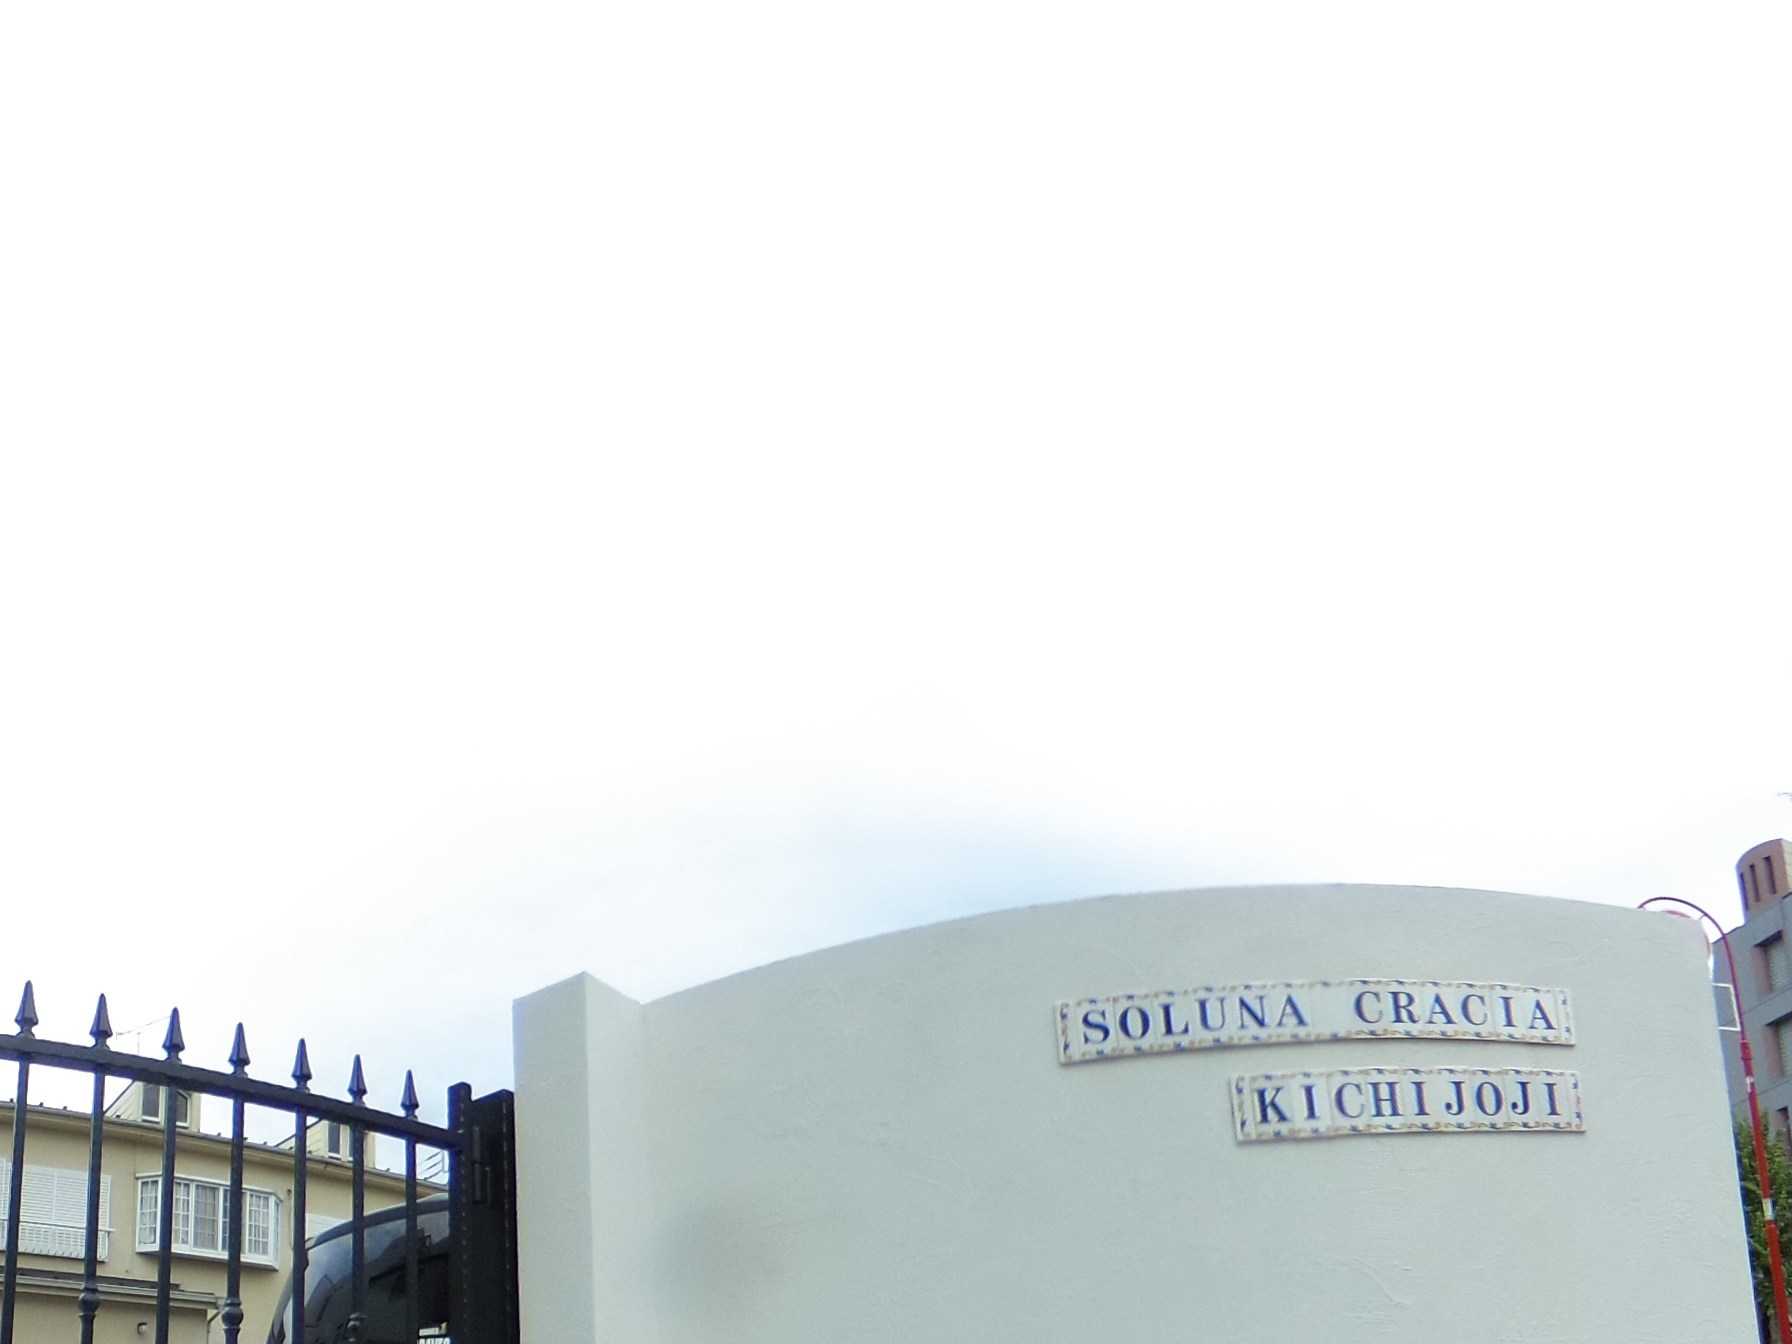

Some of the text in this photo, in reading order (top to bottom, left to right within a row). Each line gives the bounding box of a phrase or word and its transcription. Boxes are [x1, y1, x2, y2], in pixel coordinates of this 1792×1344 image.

[1081, 989, 1558, 1045] SOLUNA CRACIA
[1256, 1080, 1565, 1125] KICHIJOJI
